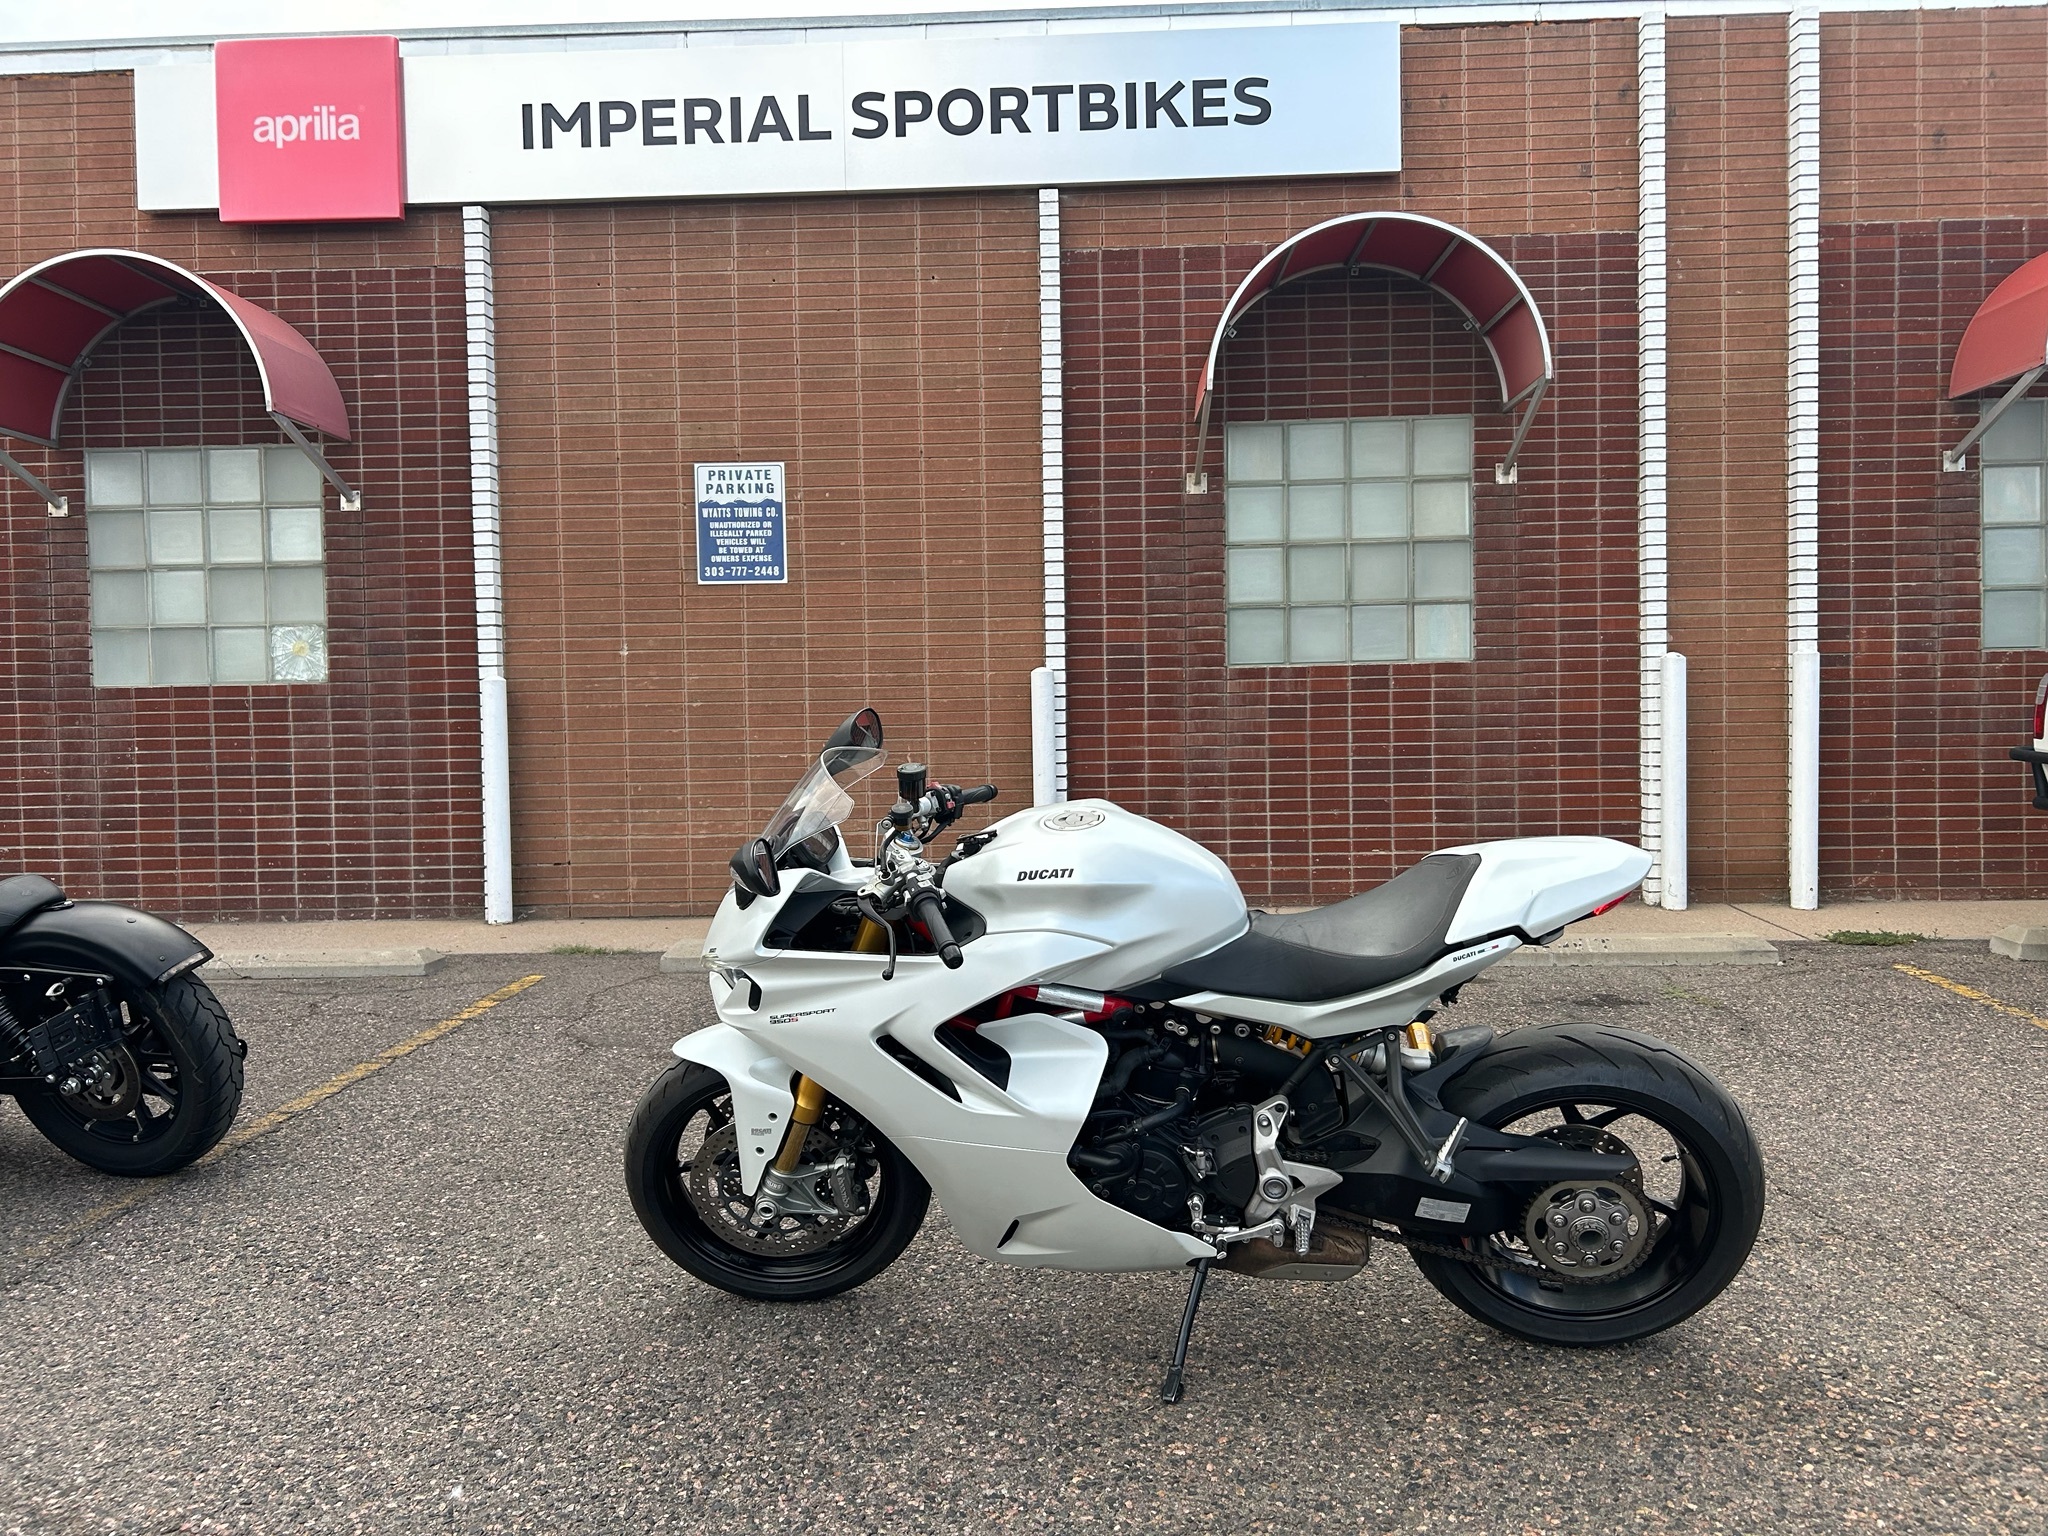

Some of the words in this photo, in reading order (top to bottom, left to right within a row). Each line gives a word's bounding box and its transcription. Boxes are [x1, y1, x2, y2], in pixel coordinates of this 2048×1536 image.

[522, 95, 831, 149] IMPERIAL
[852, 78, 1271, 139] SPORTBIKES
[254, 106, 359, 148] aprilia
[708, 470, 772, 480] PRIVATE
[705, 483, 775, 494] PARKING
[702, 507, 731, 518] WYATTS
[734, 507, 763, 518] TOWING
[766, 507, 779, 517] CO.
[709, 521, 761, 529] UNAUTHORIZED
[716, 538, 748, 546] VEHICLES
[718, 546, 727, 554] BE
[729, 546, 753, 554] TOWED
[711, 555, 740, 563] OWNERS
[704, 566, 780, 577] 303-777-2448
[1017, 868, 1074, 881] DUCATI
[1453, 951, 1476, 962] DUCATI
[769, 1008, 836, 1019] SUPERSPORT
